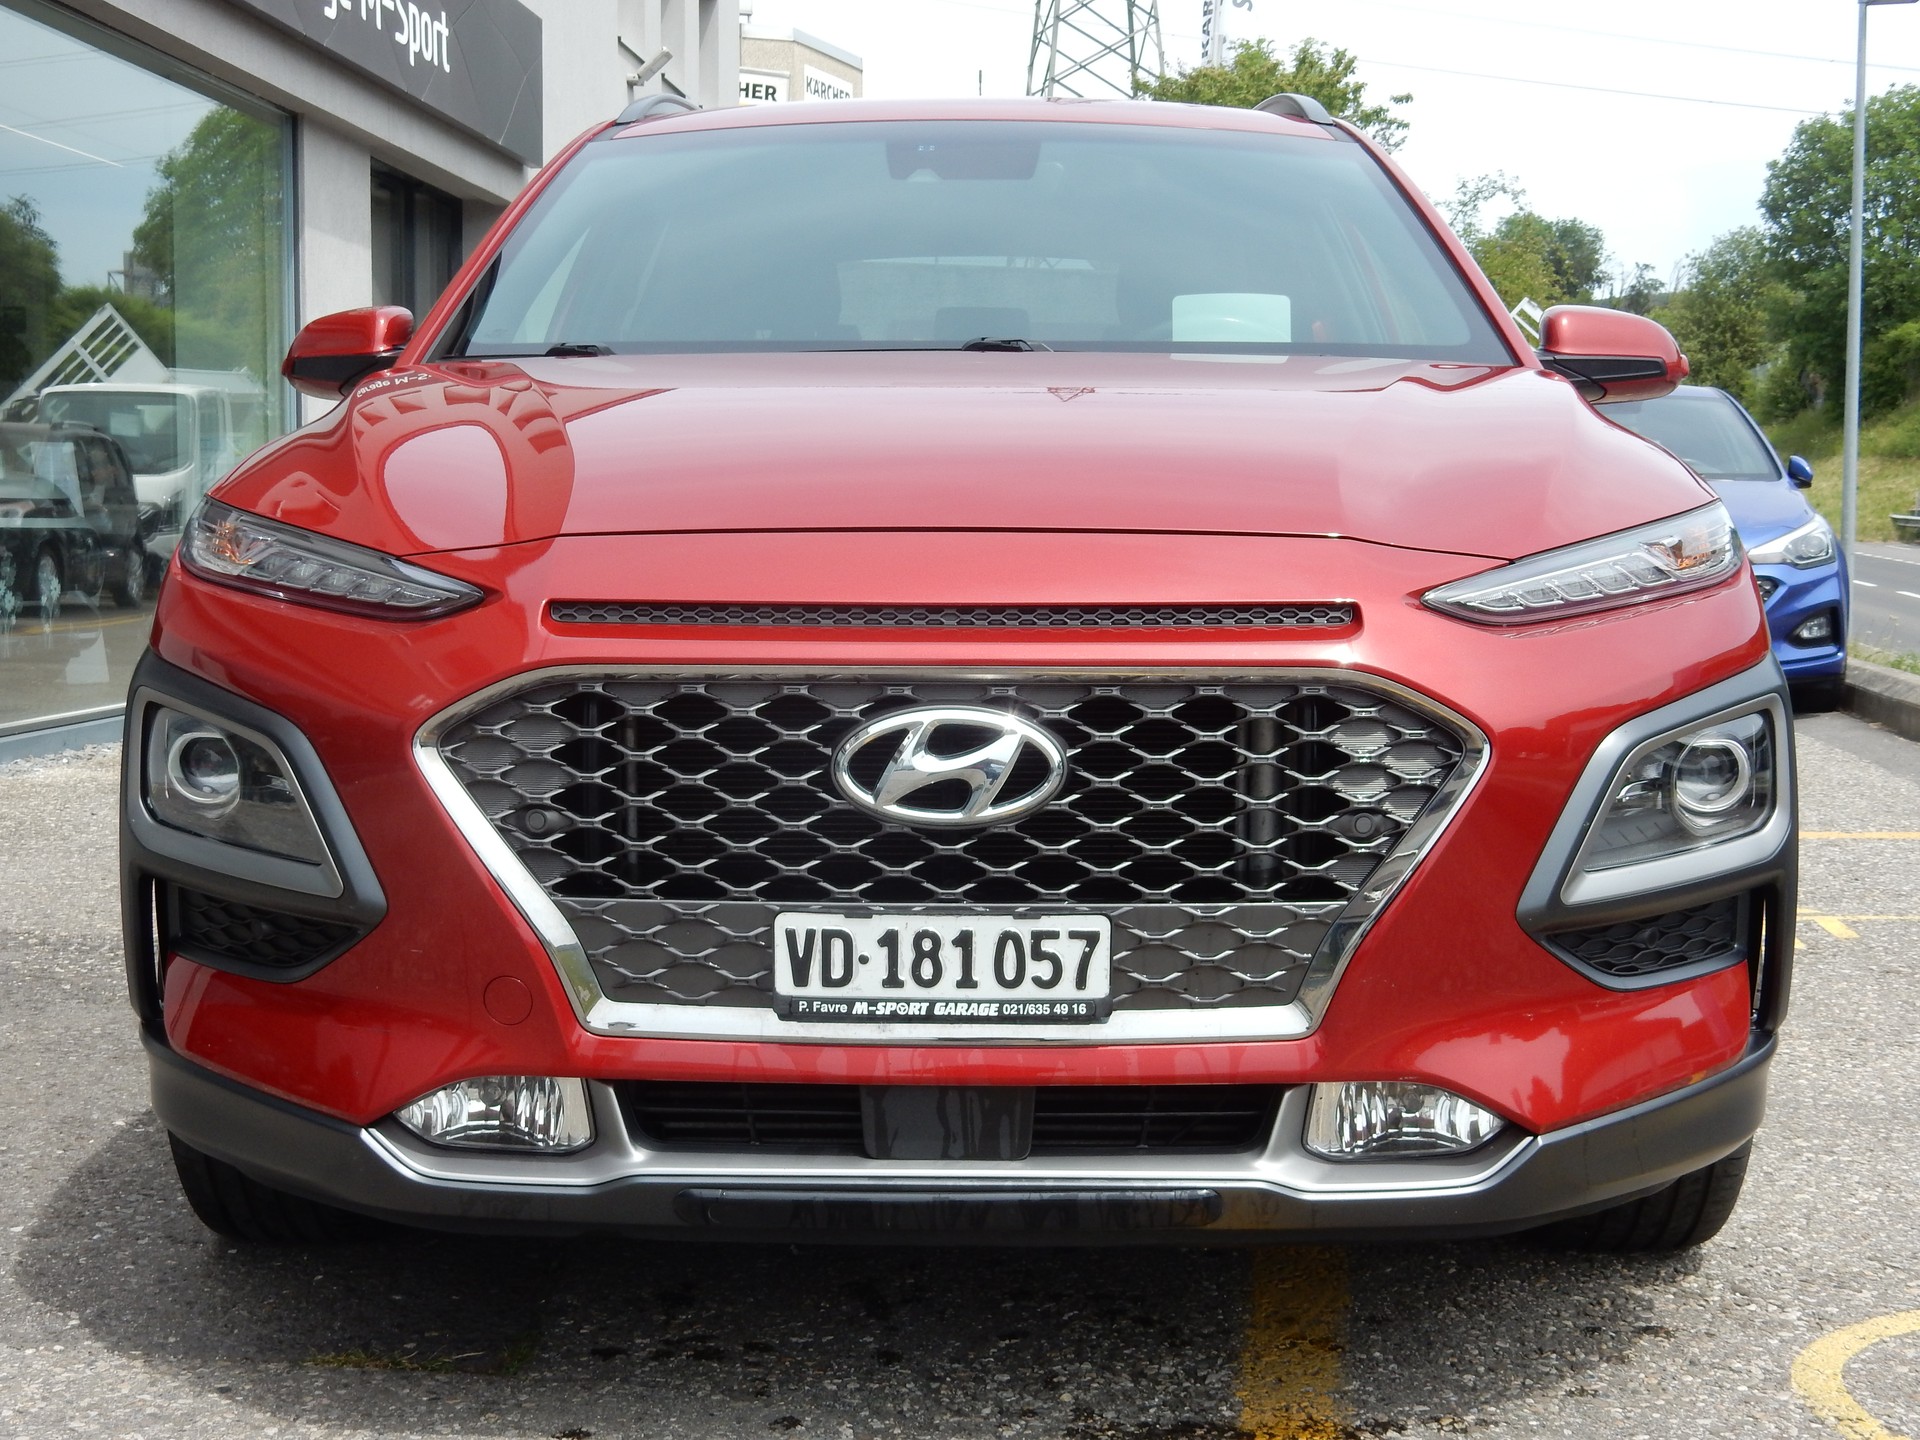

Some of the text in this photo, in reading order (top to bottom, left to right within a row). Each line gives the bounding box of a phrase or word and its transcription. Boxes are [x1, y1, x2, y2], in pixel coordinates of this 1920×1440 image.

[799, 1001, 1087, 1016] P. Favre M-SPORT GARAGE 021/635 49 16
